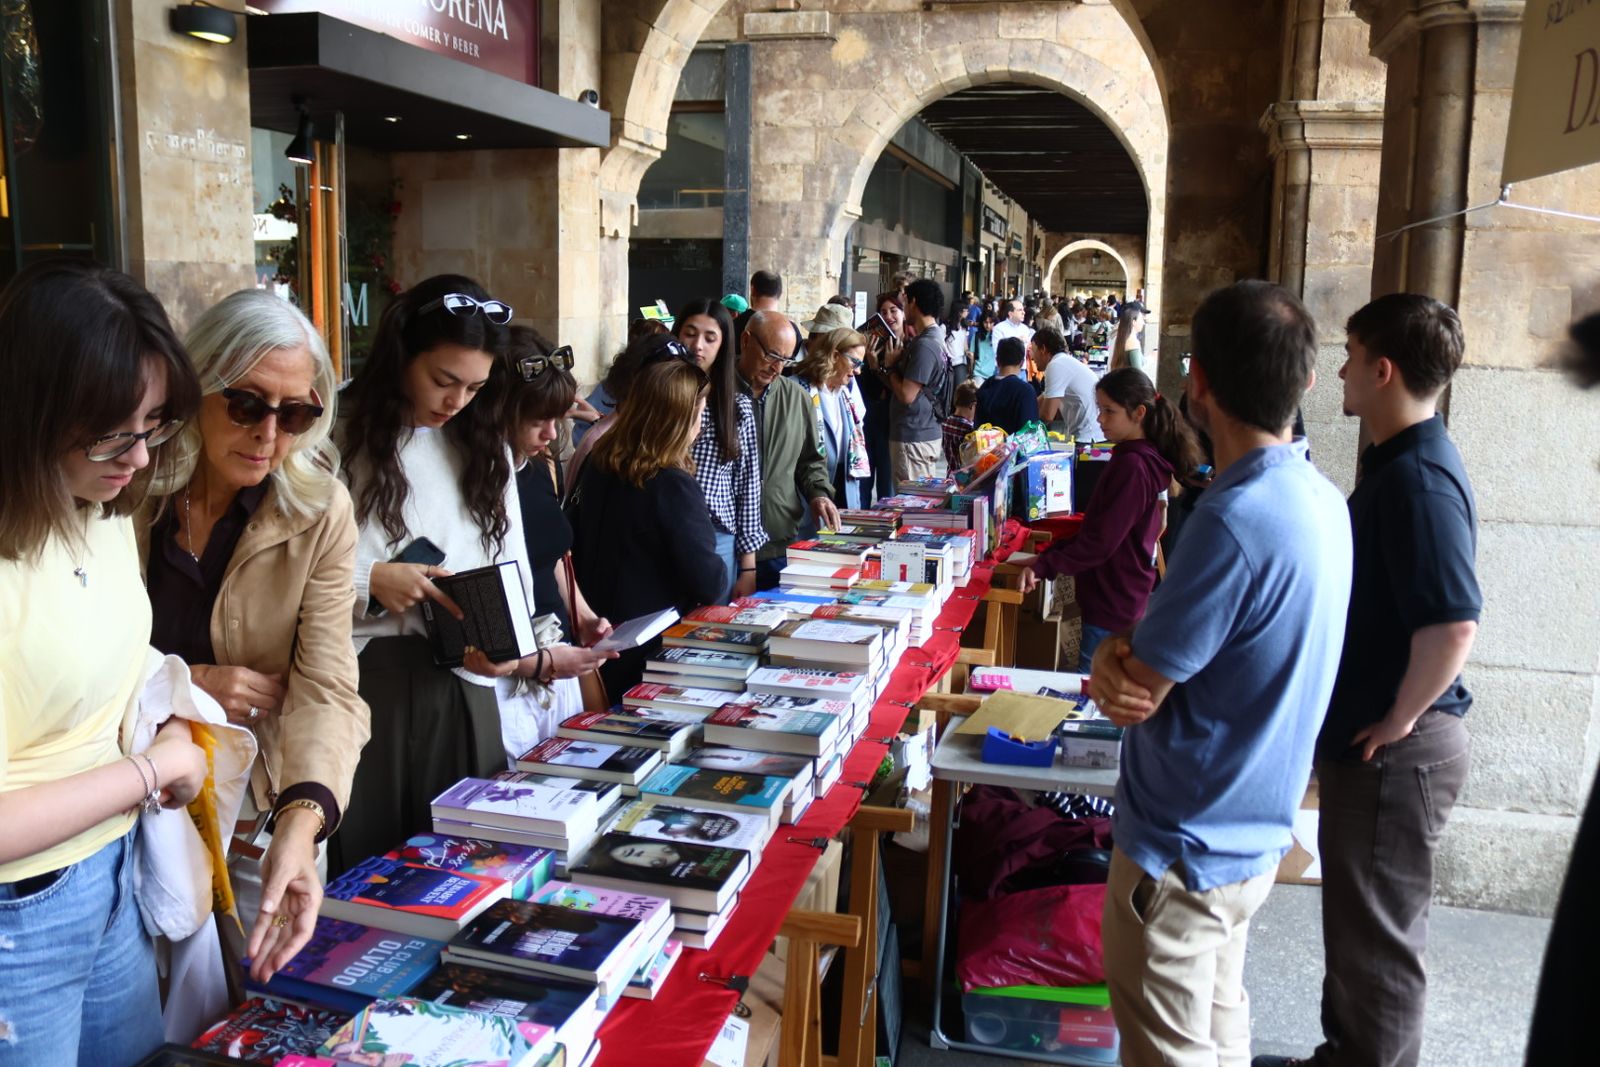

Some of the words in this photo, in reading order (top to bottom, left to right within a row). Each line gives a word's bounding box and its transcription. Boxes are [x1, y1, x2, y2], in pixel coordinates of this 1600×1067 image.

[404, 17, 441, 44] COMER
[443, 31, 450, 47] Y
[452, 36, 480, 58] BEBER
[404, 940, 426, 950] EL
[332, 940, 402, 986] OLVIDO
[377, 951, 412, 974] CLUB
